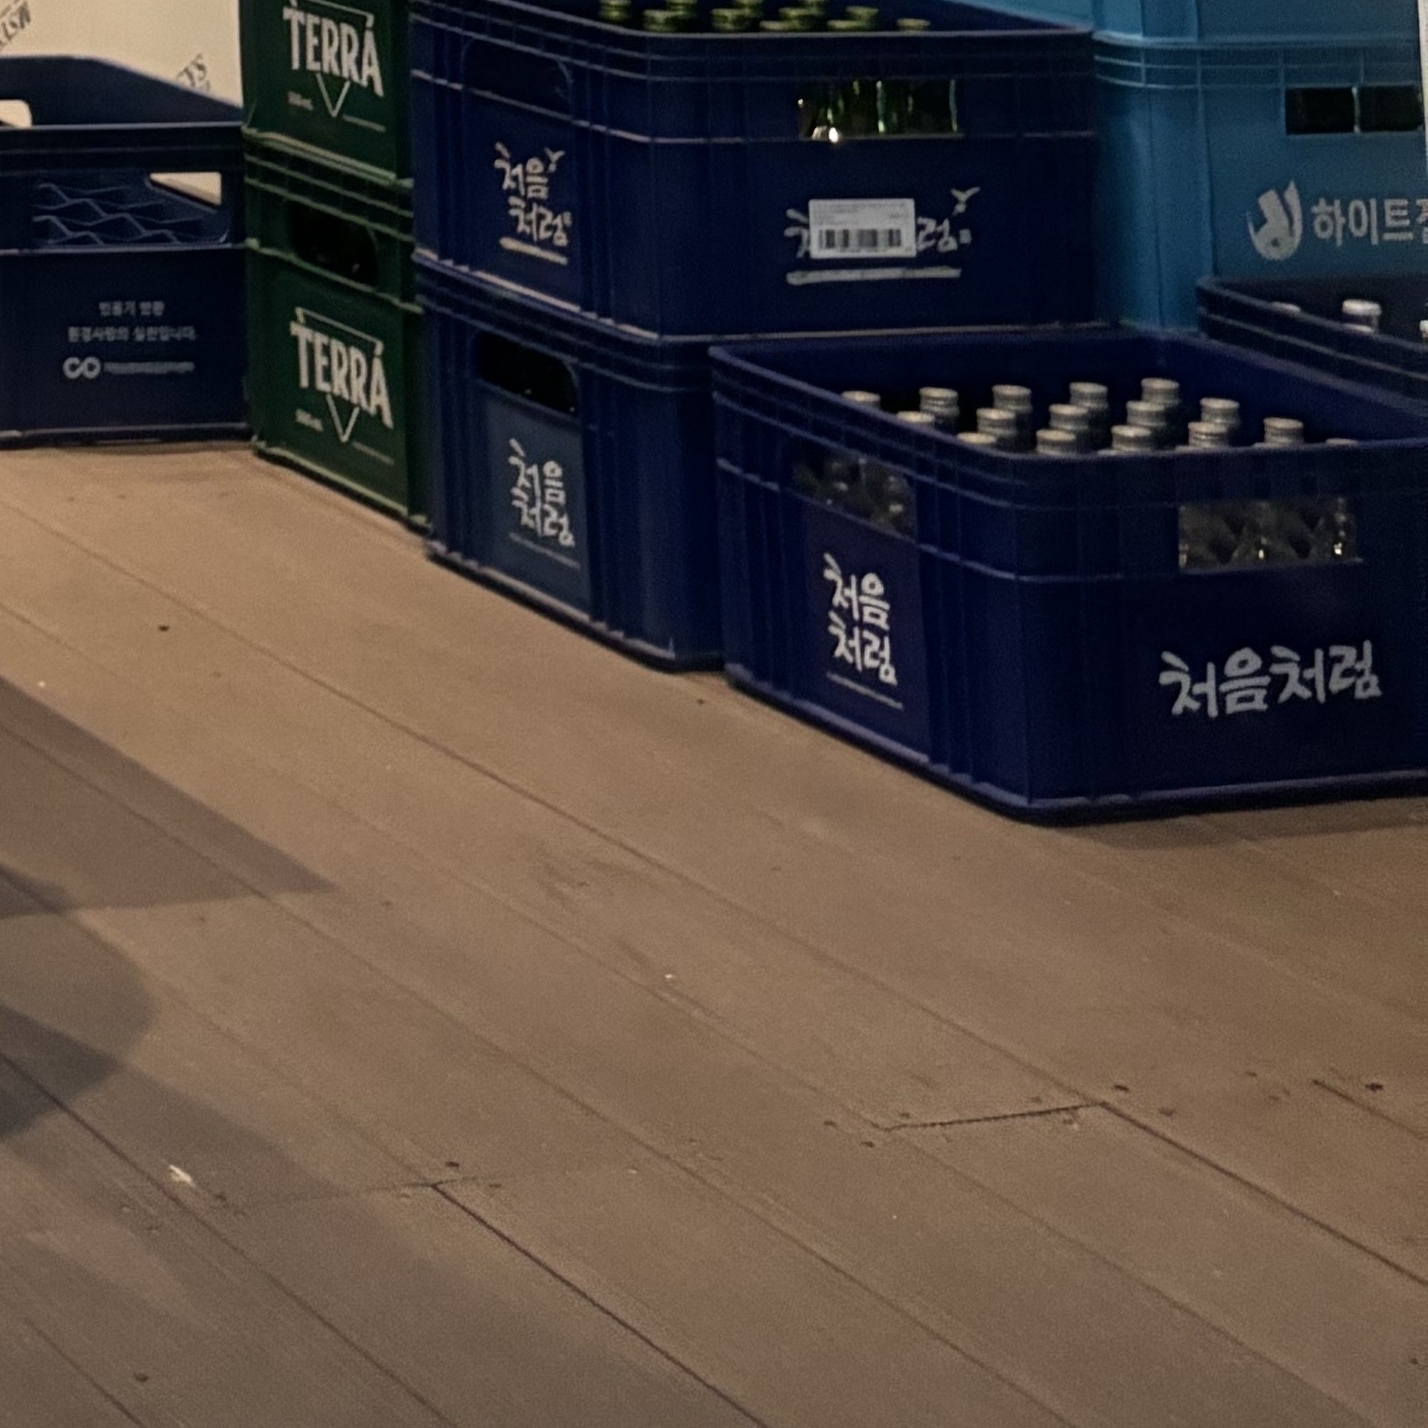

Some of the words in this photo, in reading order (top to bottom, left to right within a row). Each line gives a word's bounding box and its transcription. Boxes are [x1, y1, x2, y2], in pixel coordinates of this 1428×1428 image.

[282, 6, 384, 98] TERRA
[493, 141, 549, 200] 처음
[289, 321, 394, 430] TERRA
[508, 438, 565, 506] 처음
[823, 552, 891, 631] 처음
[827, 610, 898, 686] 처럼
[1158, 639, 1383, 720] 처음처럼
